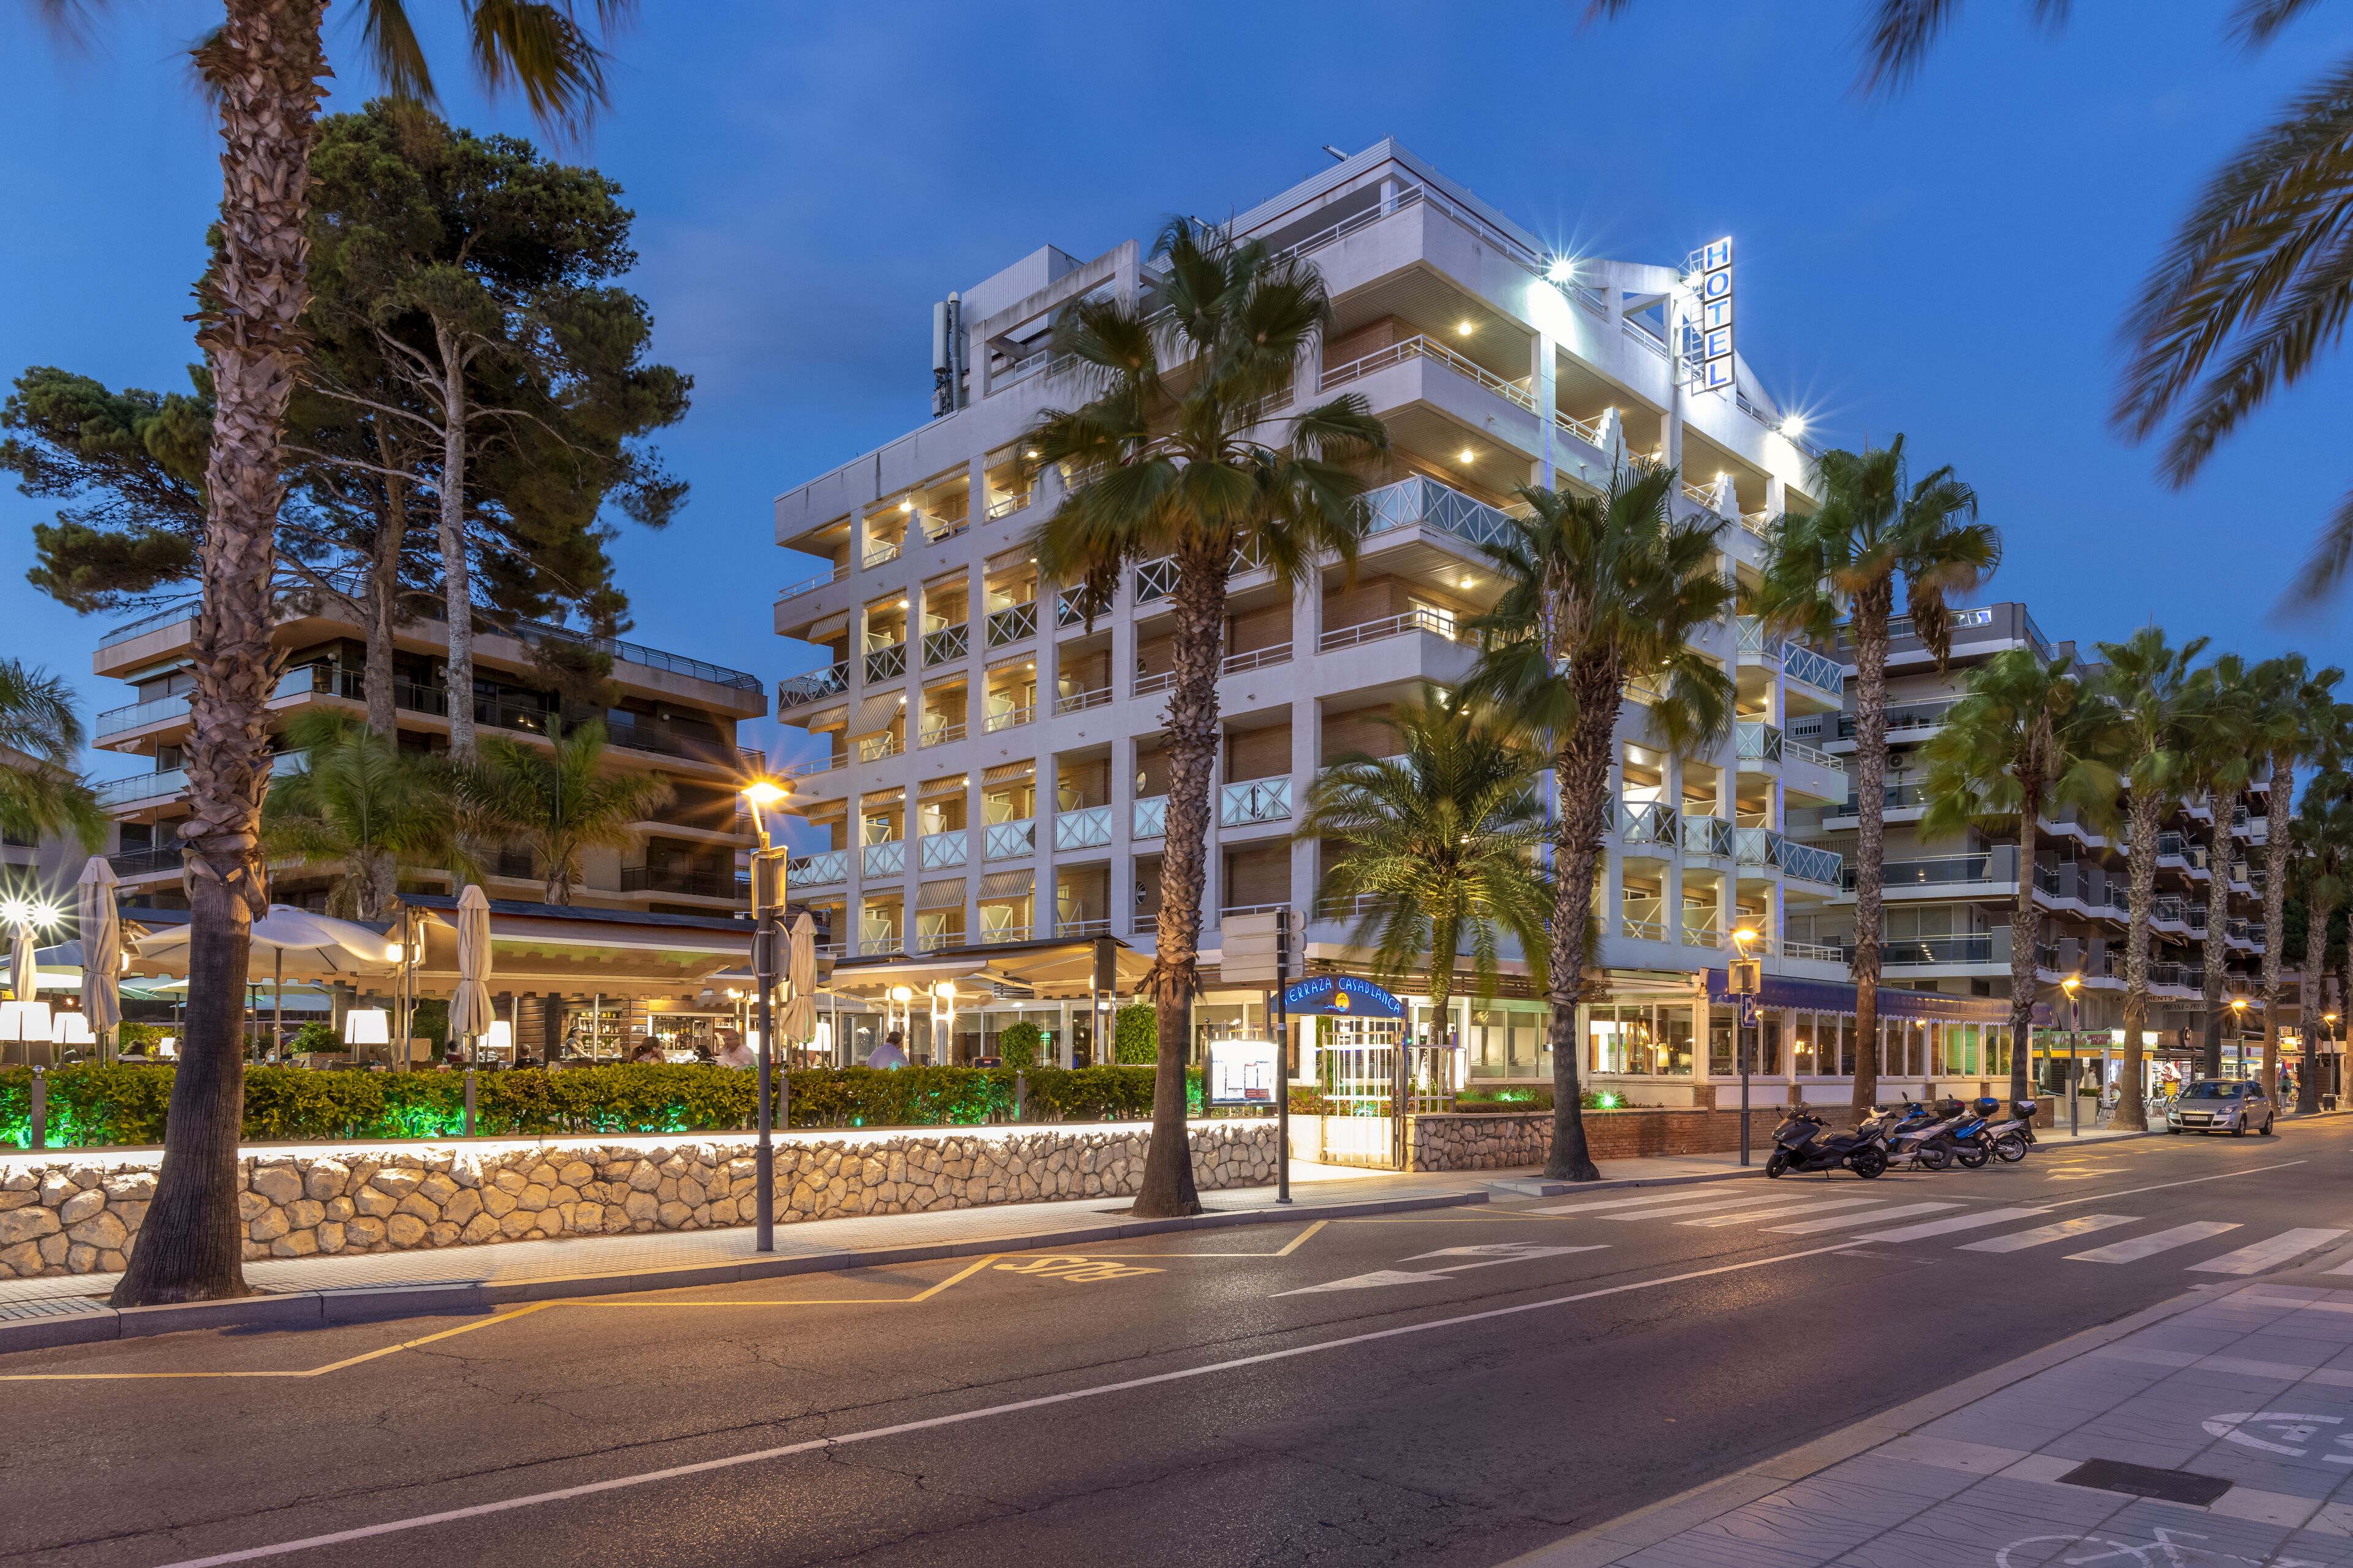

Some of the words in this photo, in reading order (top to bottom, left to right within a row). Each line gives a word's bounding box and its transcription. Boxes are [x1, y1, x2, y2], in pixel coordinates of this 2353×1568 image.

[1707, 241, 1729, 386] HOTEL
[1338, 977, 1400, 1014] CASABLANCA
[1745, 997, 1753, 1023] P
[992, 1257, 1167, 1282] BUS
